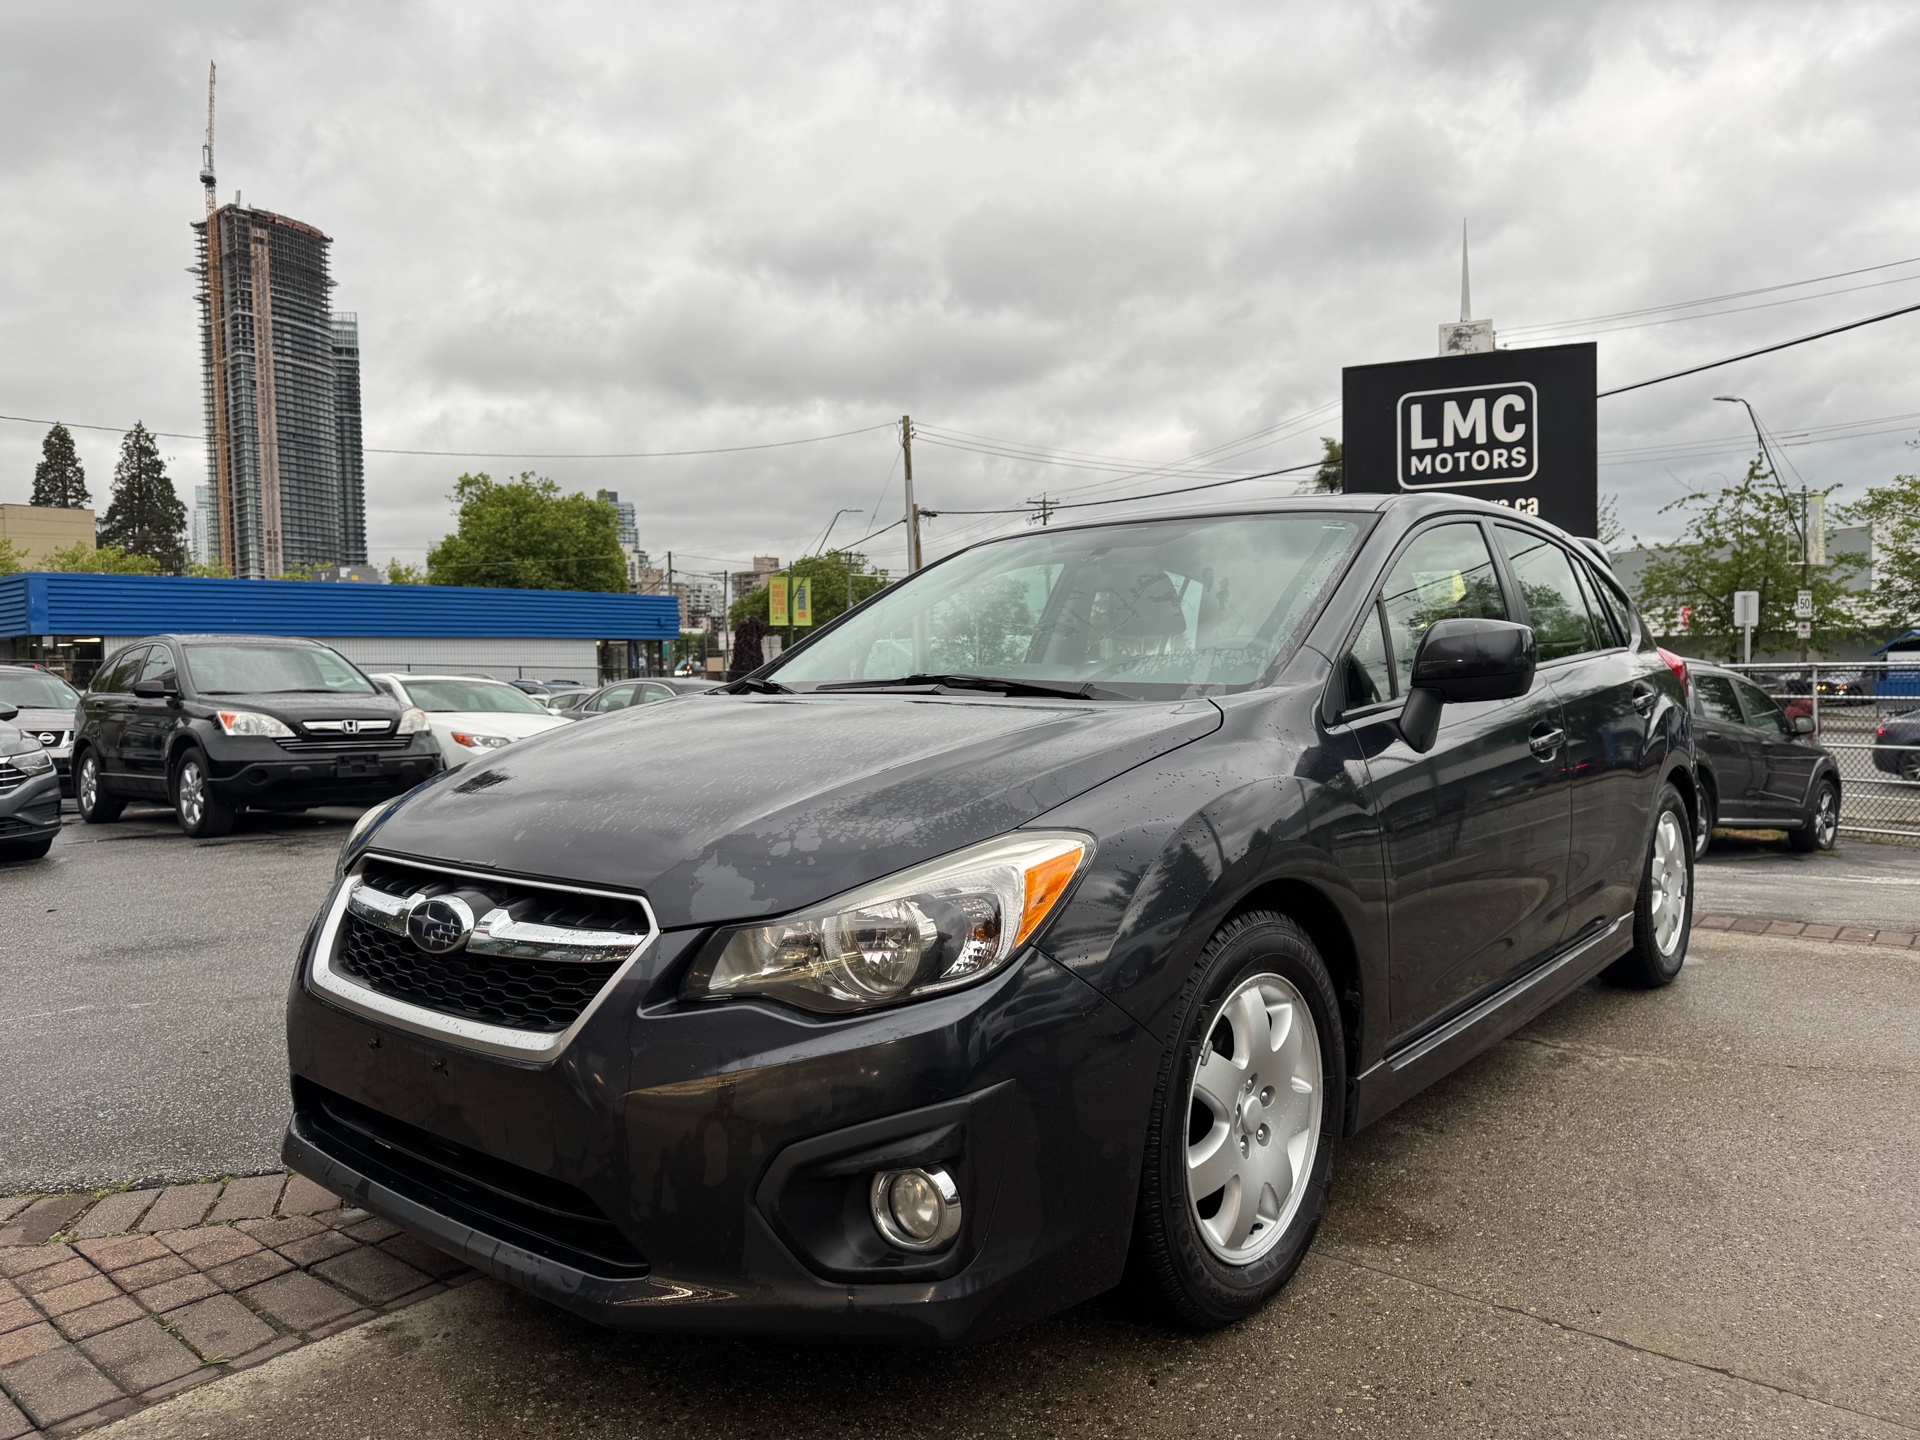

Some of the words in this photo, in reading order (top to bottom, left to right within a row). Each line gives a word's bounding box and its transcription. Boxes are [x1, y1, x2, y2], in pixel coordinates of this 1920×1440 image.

[1410, 393, 1526, 450] LMC
[1410, 446, 1527, 476] MOTORS
[1800, 597, 1810, 610] 50
